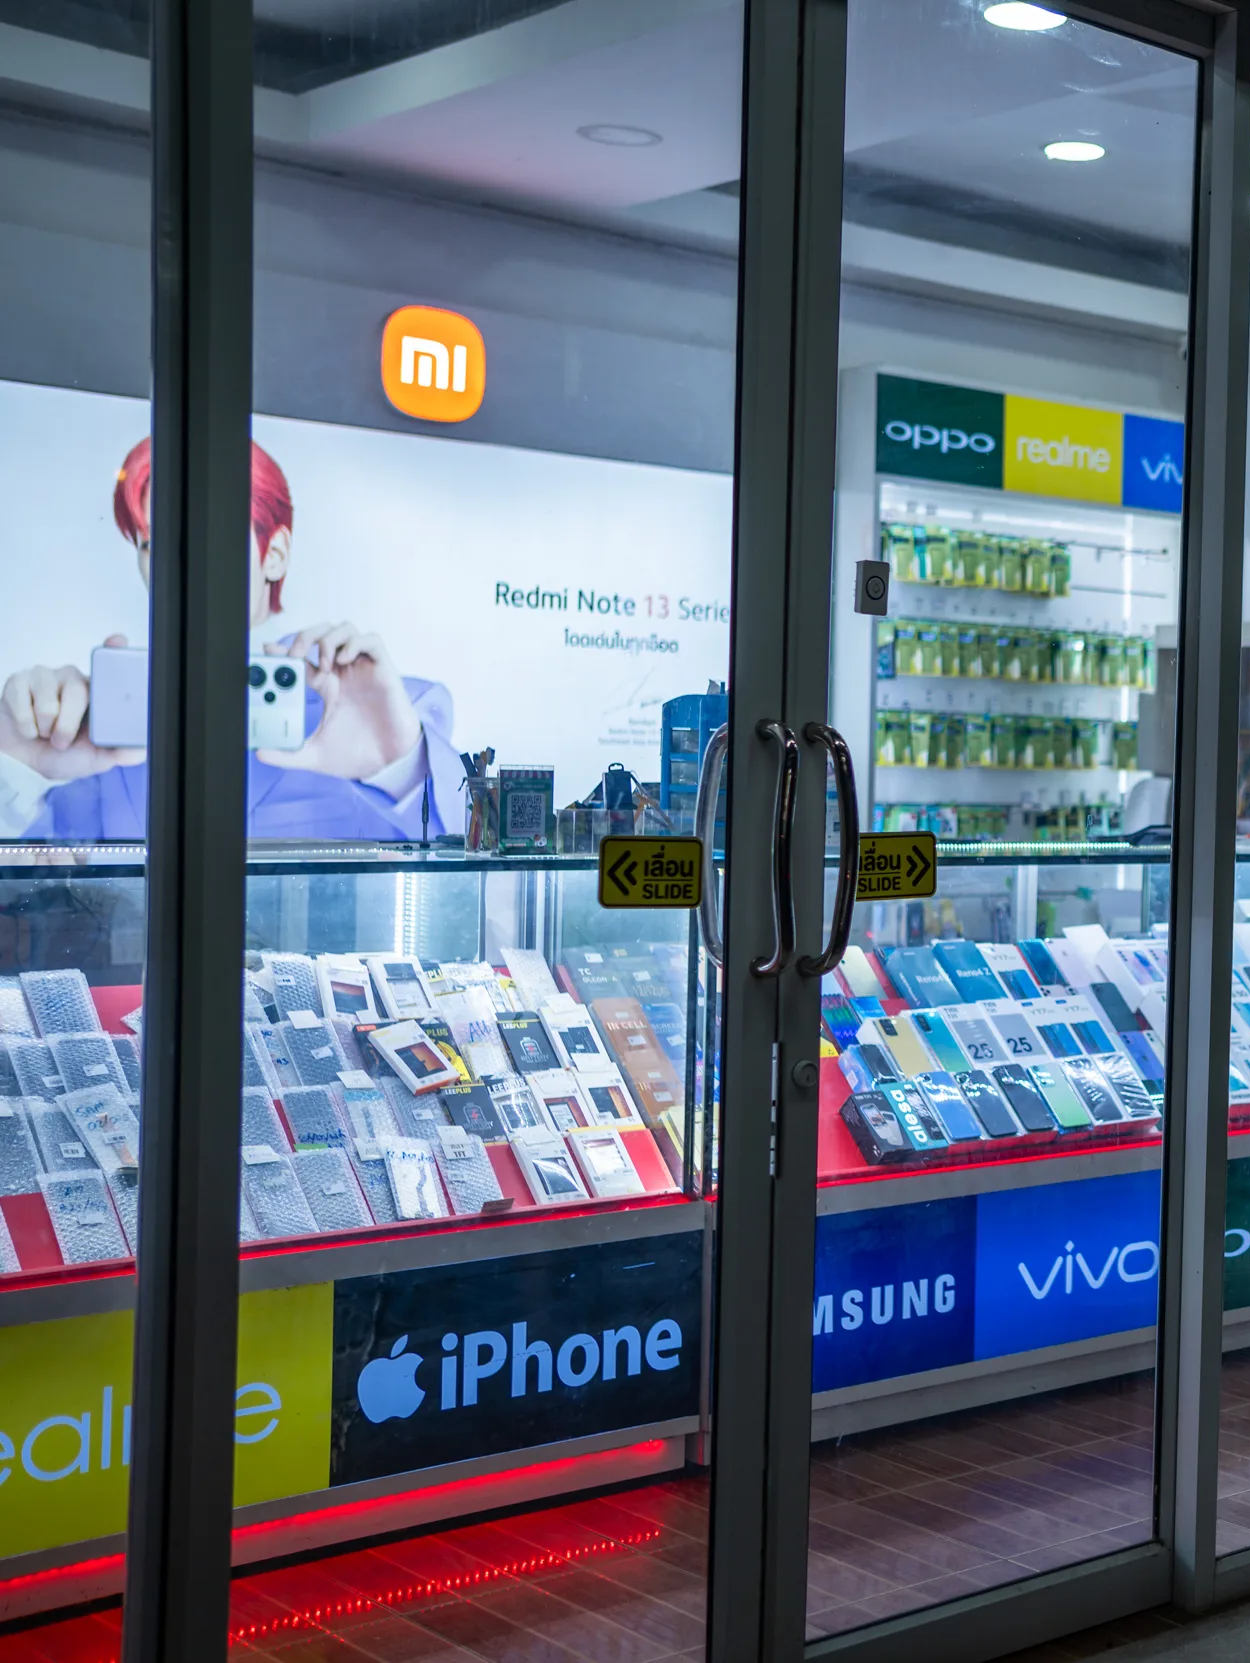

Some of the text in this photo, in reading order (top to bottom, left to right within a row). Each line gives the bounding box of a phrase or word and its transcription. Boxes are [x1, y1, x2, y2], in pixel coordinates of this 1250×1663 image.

[1016, 436, 1111, 473] realme
[495, 582, 568, 611] Redmi
[577, 590, 636, 616] Note
[645, 594, 670, 619] 13
[643, 844, 694, 877] เลื่อน
[642, 883, 694, 899] SLIDE
[858, 876, 901, 893] SLIDE
[606, 1020, 648, 1031] IN CELL
[968, 1042, 994, 1060] 25
[1007, 1037, 1033, 1054] 25
[444, 1087, 472, 1096] LEEPLUS
[487, 1078, 526, 1095] LEEPLUS
[453, 1150, 466, 1158] TFT
[440, 1317, 683, 1410] iPhone
